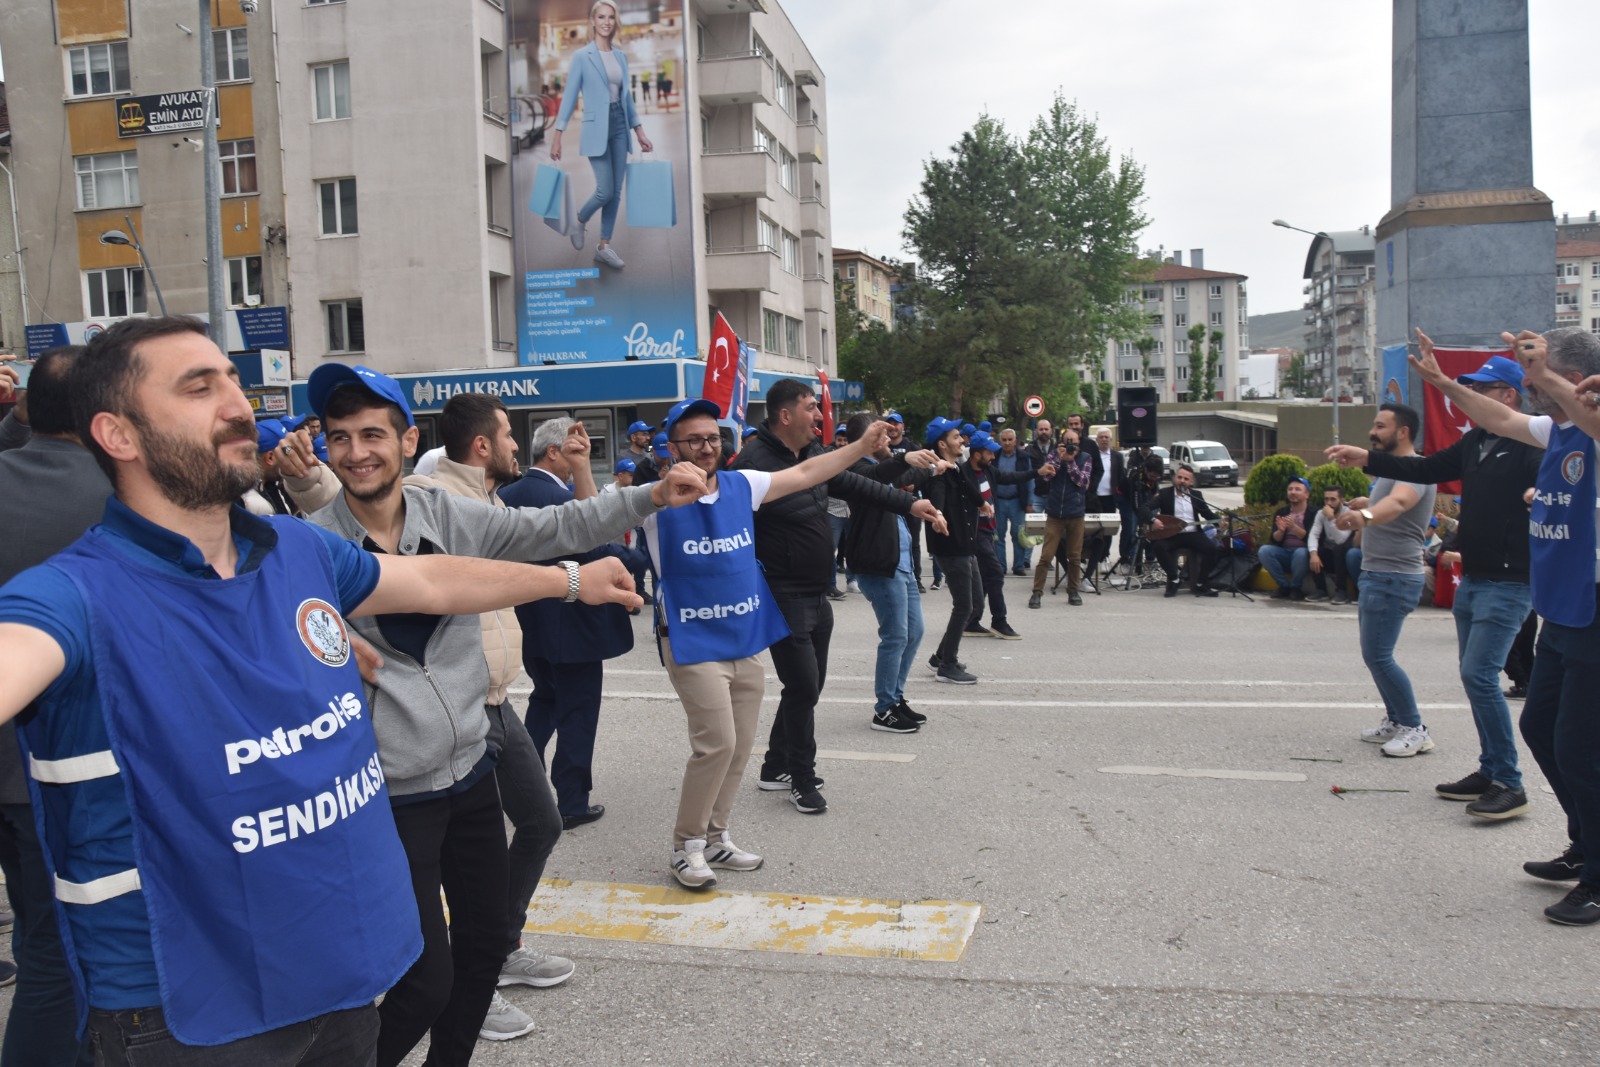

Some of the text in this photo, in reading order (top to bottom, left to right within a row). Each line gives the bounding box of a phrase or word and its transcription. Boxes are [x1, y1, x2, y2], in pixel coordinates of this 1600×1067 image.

[159, 92, 204, 107] AVUKAT
[149, 108, 203, 124] EMİN AYD
[555, 271, 580, 279] günlerine
[550, 279, 570, 287] indirimi
[548, 307, 569, 315] indirimi
[594, 318, 606, 326] gün
[538, 351, 587, 361] HALKBANK
[682, 528, 752, 555] GÖREVLİ
[224, 692, 362, 775] petrol-iş
[231, 752, 385, 853] SENDİKASI
